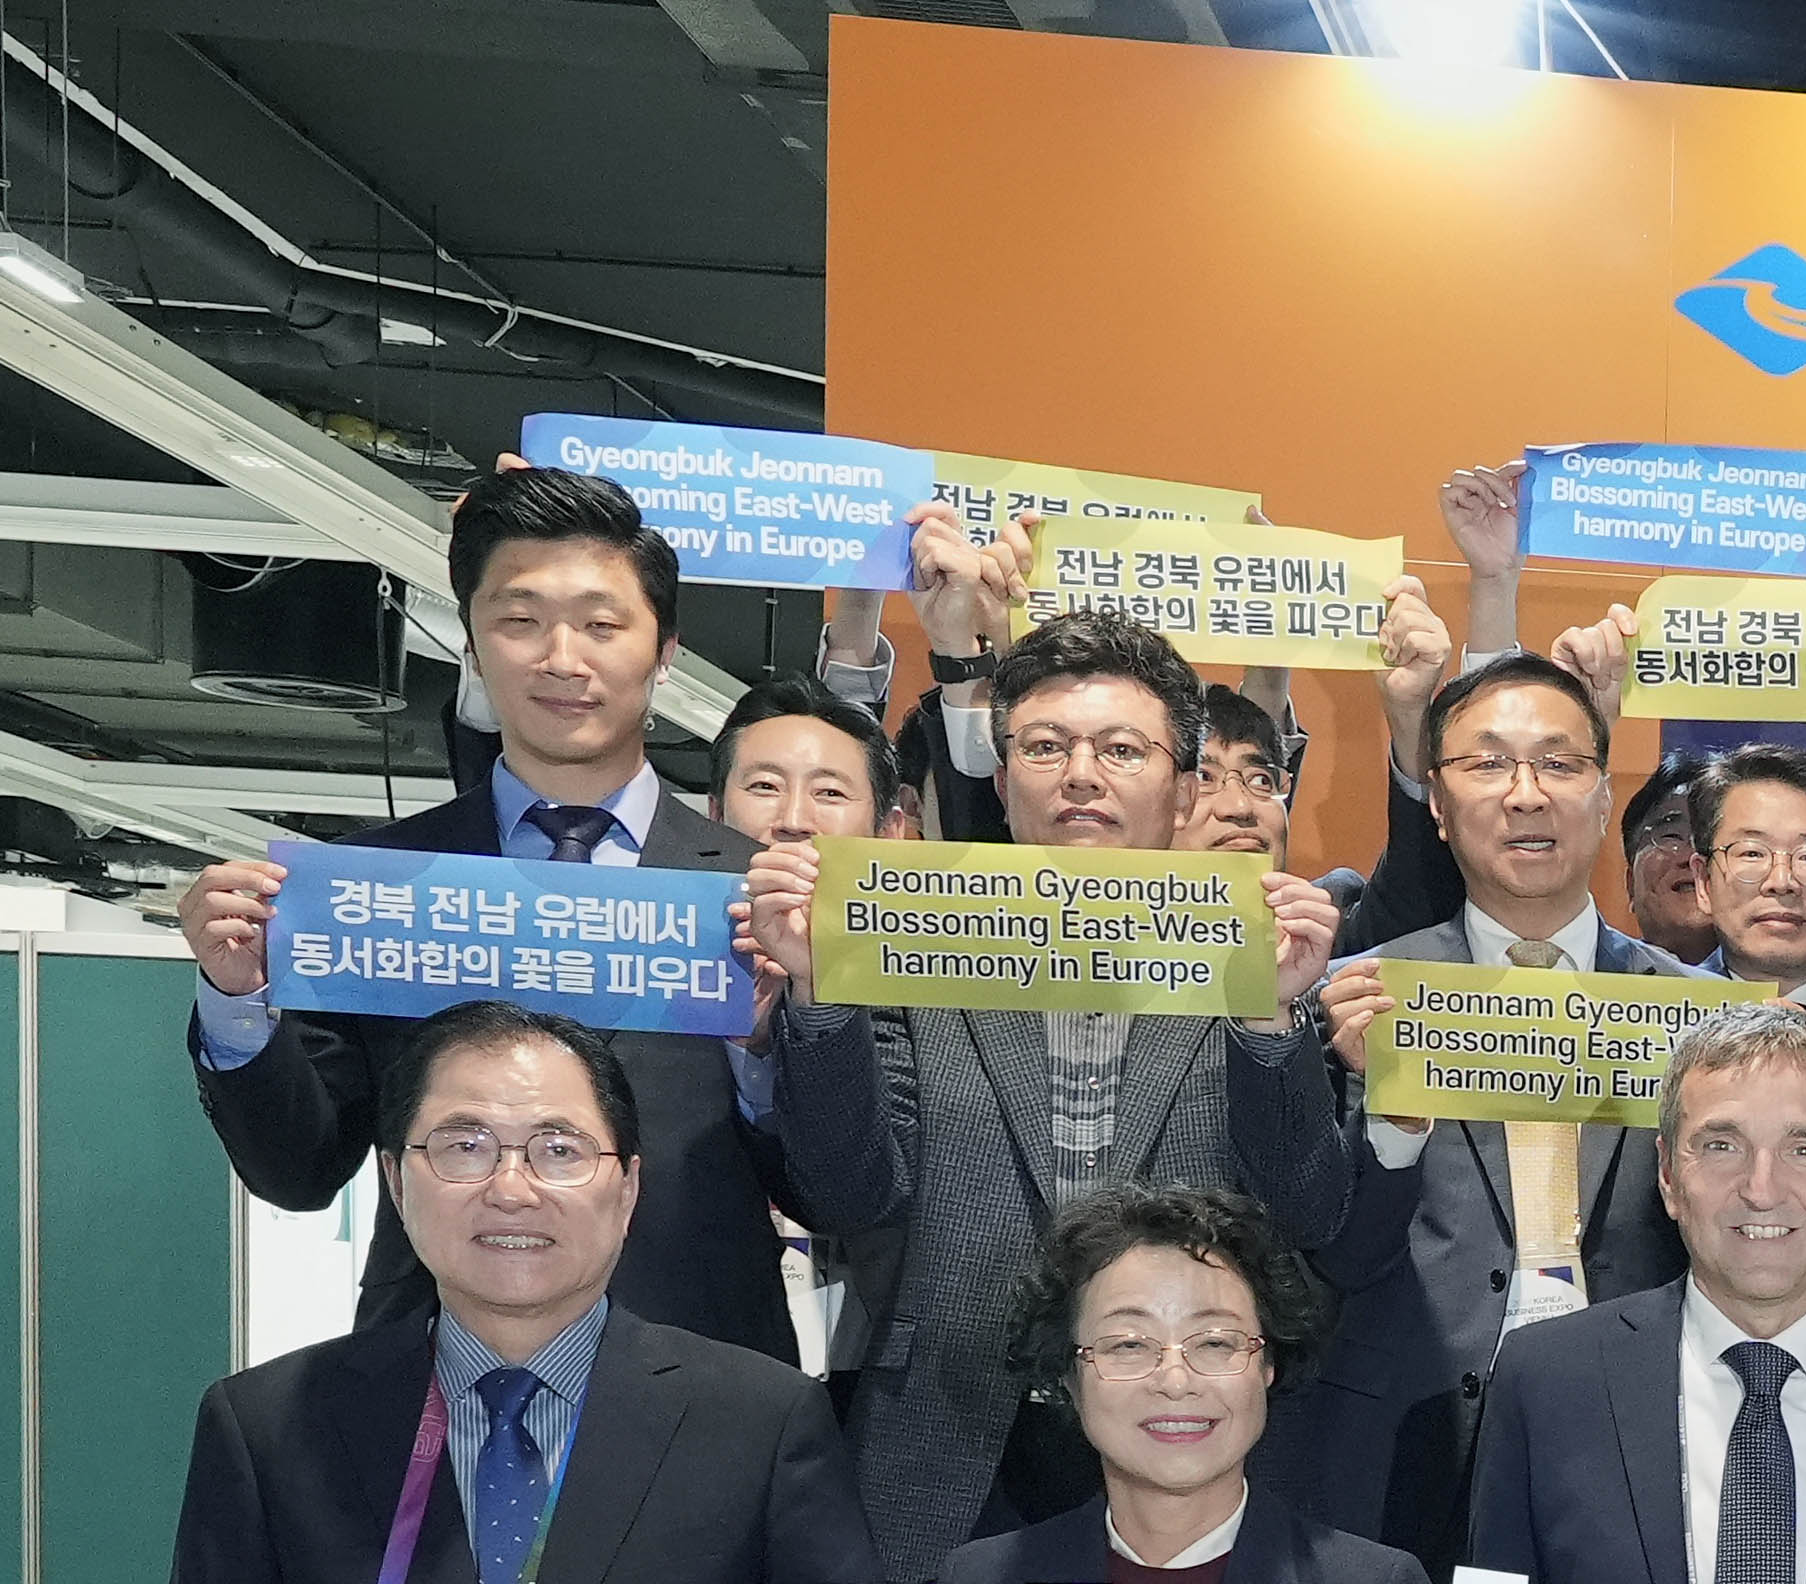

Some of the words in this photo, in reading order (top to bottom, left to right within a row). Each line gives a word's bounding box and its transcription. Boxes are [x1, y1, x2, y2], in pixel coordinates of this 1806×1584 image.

[1562, 453, 1702, 484] Gyeongbuk
[1551, 477, 1694, 516] Blossoming
[1573, 510, 1686, 549] harmony
[1691, 519, 1713, 545] in
[1719, 524, 1806, 557] Europe
[1056, 549, 1124, 588] 전남
[1133, 552, 1200, 590] 경북
[1212, 554, 1348, 596] 유럽에서
[1208, 597, 1278, 636] 꽃을
[1287, 601, 1387, 638] 피우다
[1663, 608, 1726, 648] 전남
[1738, 609, 1802, 648] 경북
[1634, 649, 1797, 689] 동서화합의
[857, 861, 1022, 898] Jeonnam
[1034, 869, 1230, 908] Gyeongbuk
[330, 878, 414, 927] 경북
[429, 887, 520, 933] 전남
[533, 893, 696, 947] 유럽에서
[847, 902, 1049, 945] Blossoming
[1061, 910, 1244, 945] East-West
[290, 932, 500, 987] 동서화합의
[511, 947, 596, 994] 꽃을
[606, 953, 733, 1002] 피우다
[882, 944, 1039, 985] harmony
[1050, 948, 1079, 980] in
[1091, 951, 1211, 990] Europe
[1406, 984, 1553, 1017] Jeonnam
[1395, 1020, 1575, 1064] Blossoming
[1425, 1060, 1564, 1100] harmony
[1575, 1068, 1600, 1096] in
